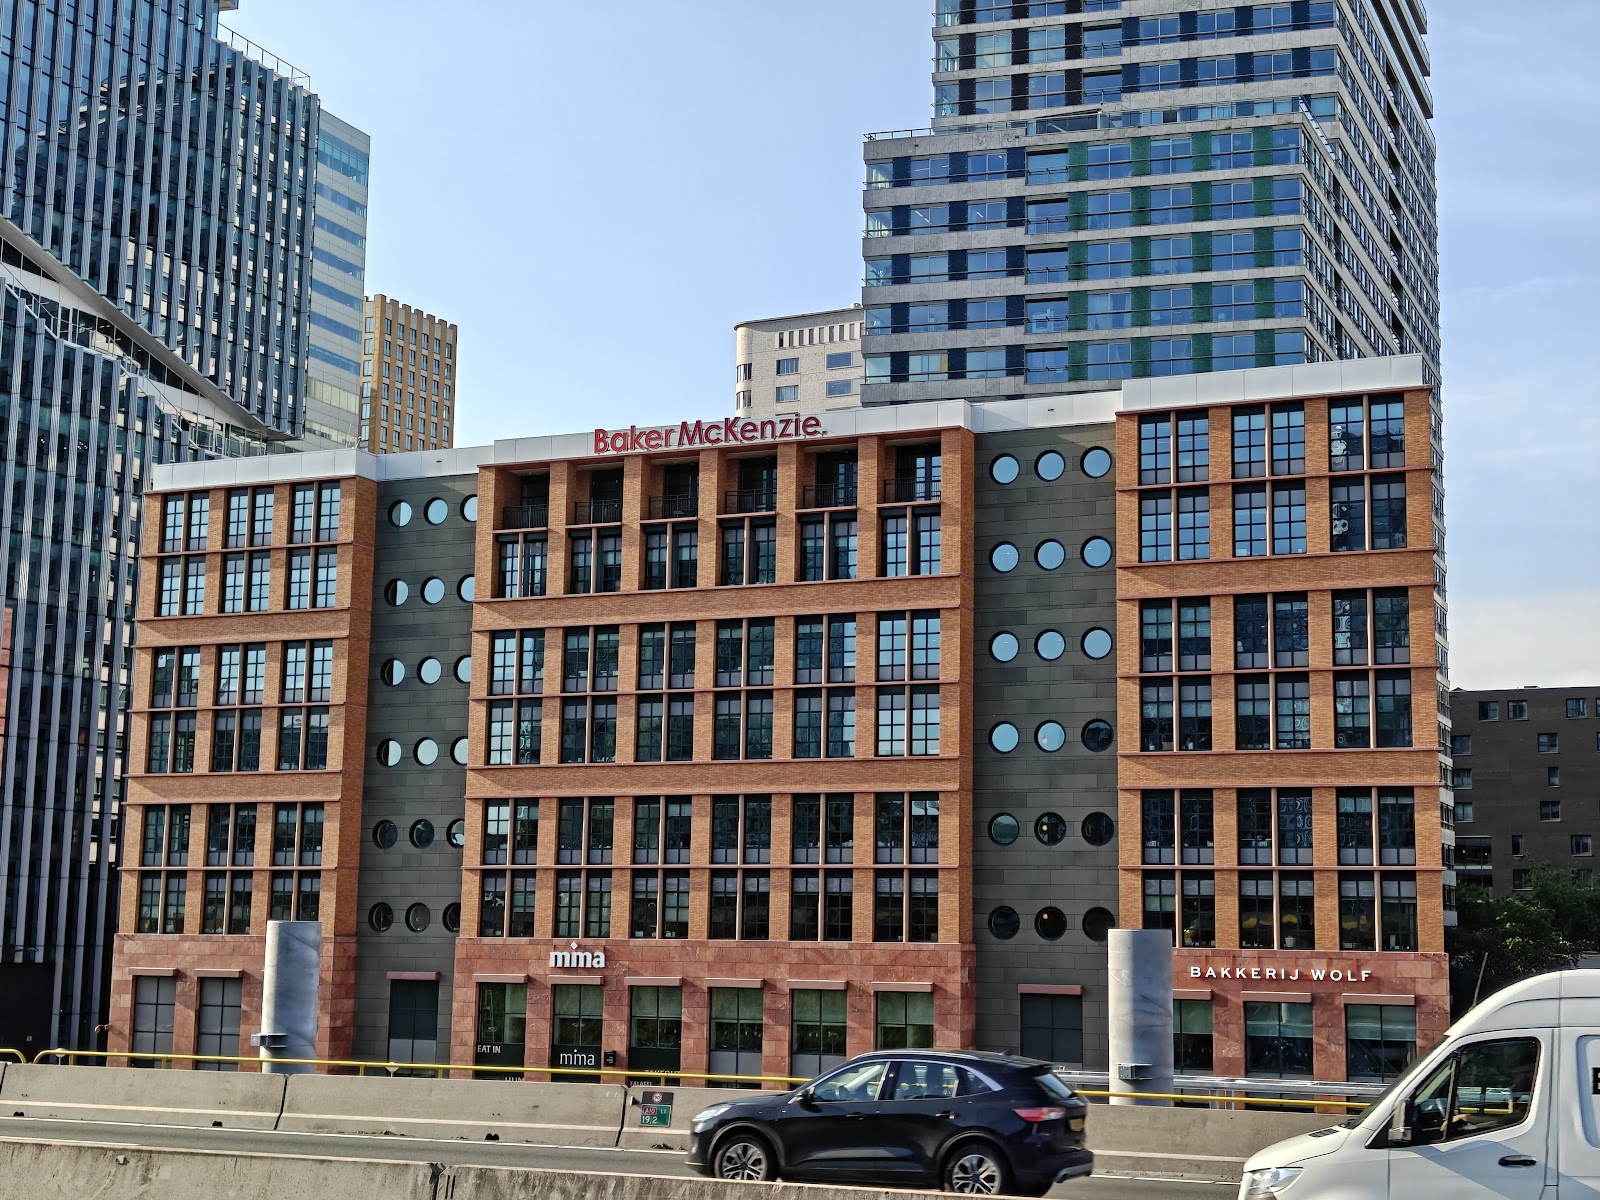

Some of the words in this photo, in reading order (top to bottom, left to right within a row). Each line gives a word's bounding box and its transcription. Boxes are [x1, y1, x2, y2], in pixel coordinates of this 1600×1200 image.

[594, 425, 676, 454] Baker
[1190, 966, 1299, 981] BAKKERIJ
[1311, 969, 1372, 982] WOLF
[477, 1045, 491, 1053] EAT
[492, 1045, 501, 1054] IN
